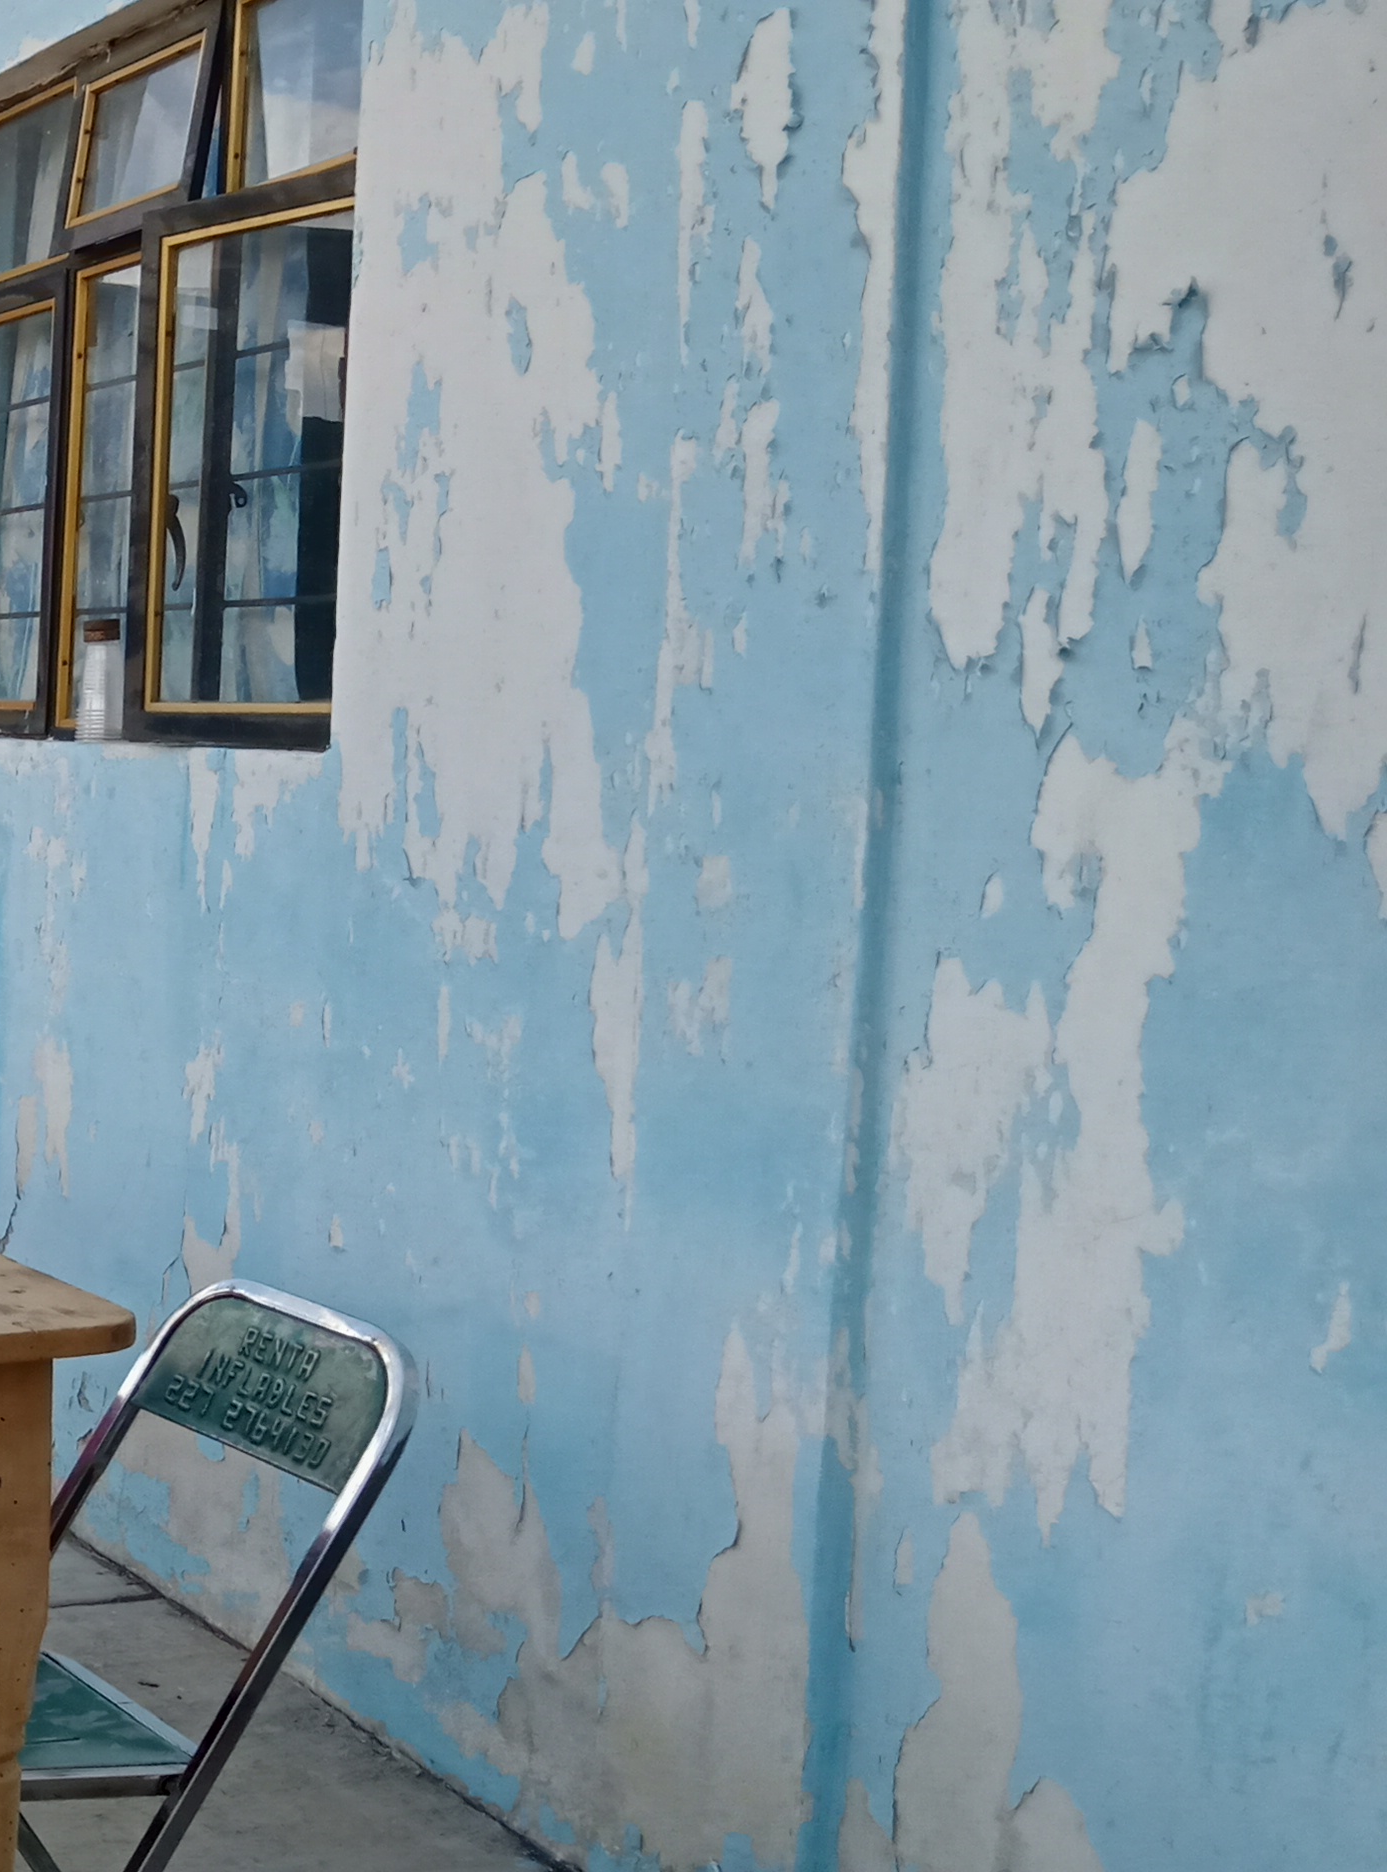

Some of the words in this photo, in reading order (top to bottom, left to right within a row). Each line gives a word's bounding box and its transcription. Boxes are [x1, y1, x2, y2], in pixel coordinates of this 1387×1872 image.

[238, 1326, 321, 1382] RENTA
[164, 1373, 215, 1418] 227
[196, 1347, 333, 1429] INFLABLES
